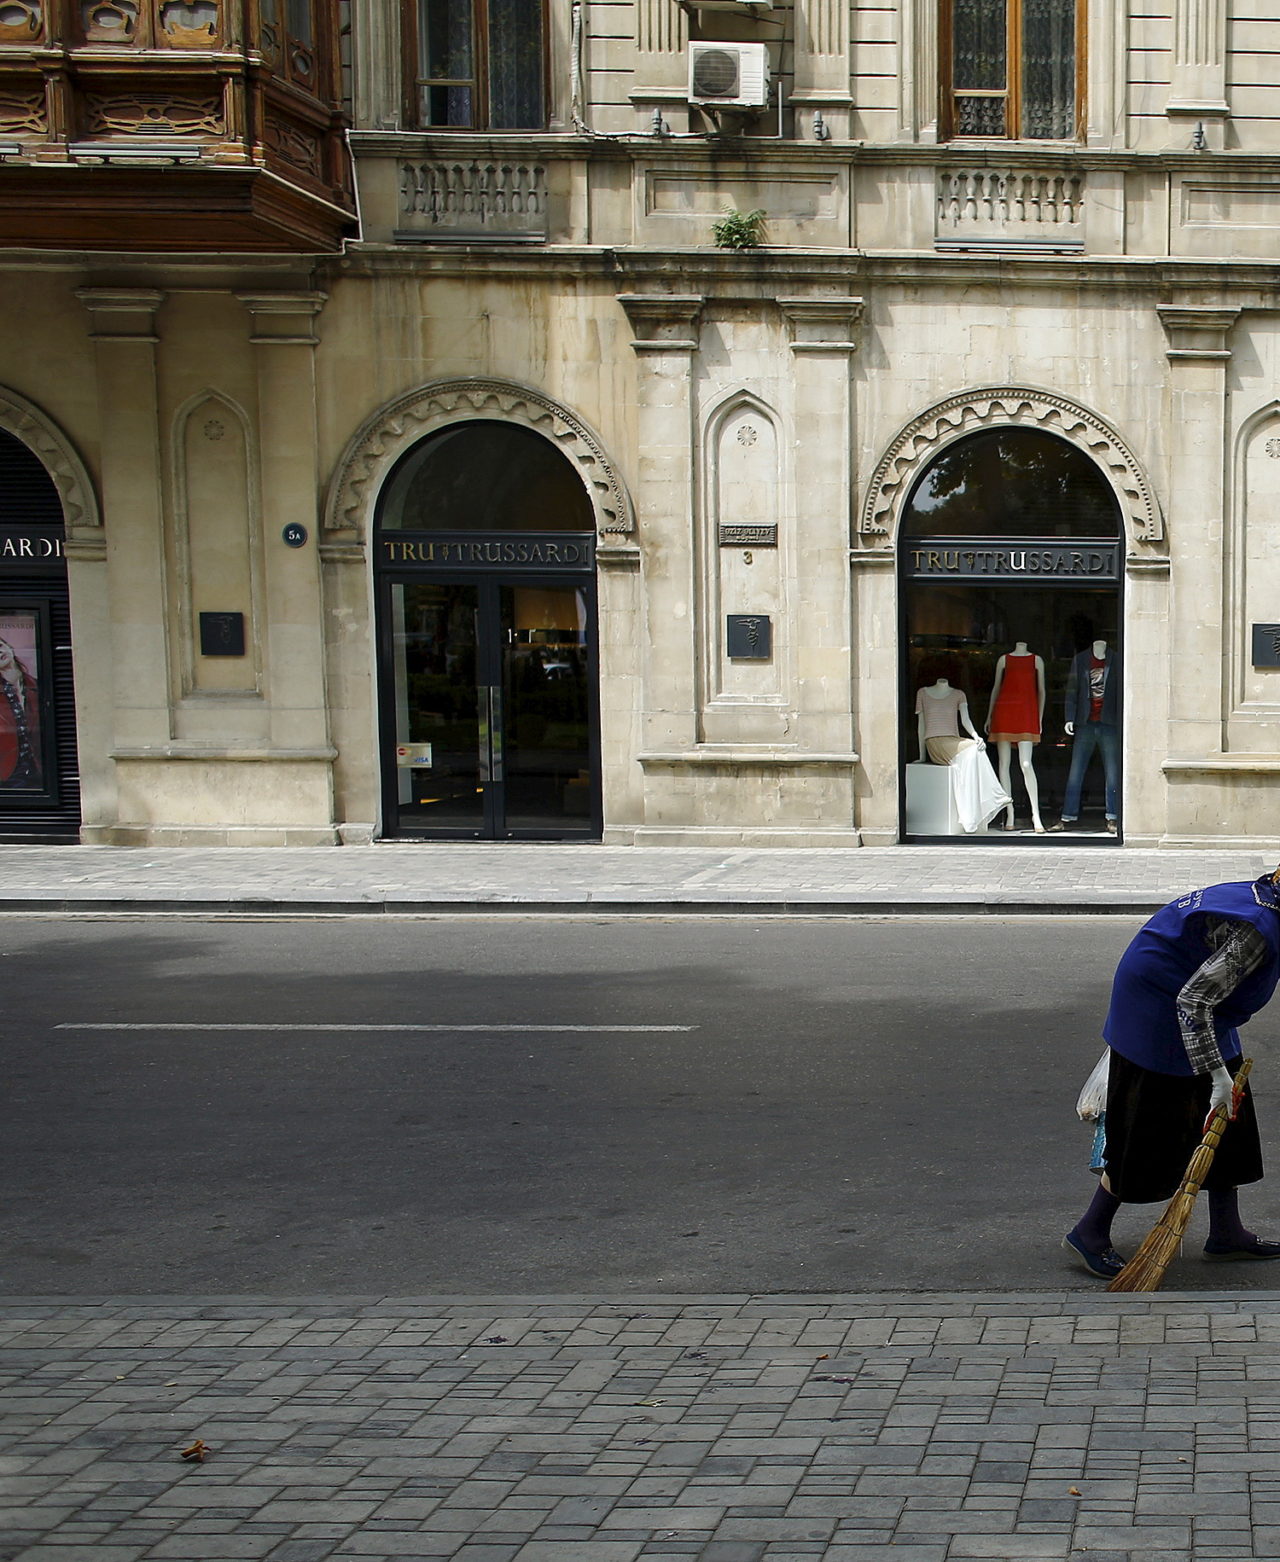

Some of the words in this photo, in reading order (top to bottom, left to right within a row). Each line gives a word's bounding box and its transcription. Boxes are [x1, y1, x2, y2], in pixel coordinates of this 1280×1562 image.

[0, 538, 61, 557] ARDI
[384, 541, 434, 561] TRU
[450, 542, 589, 563] TRUSSARDI
[743, 550, 754, 566] 3
[910, 550, 961, 572] TRU
[976, 551, 1114, 574] TRUSSARDI
